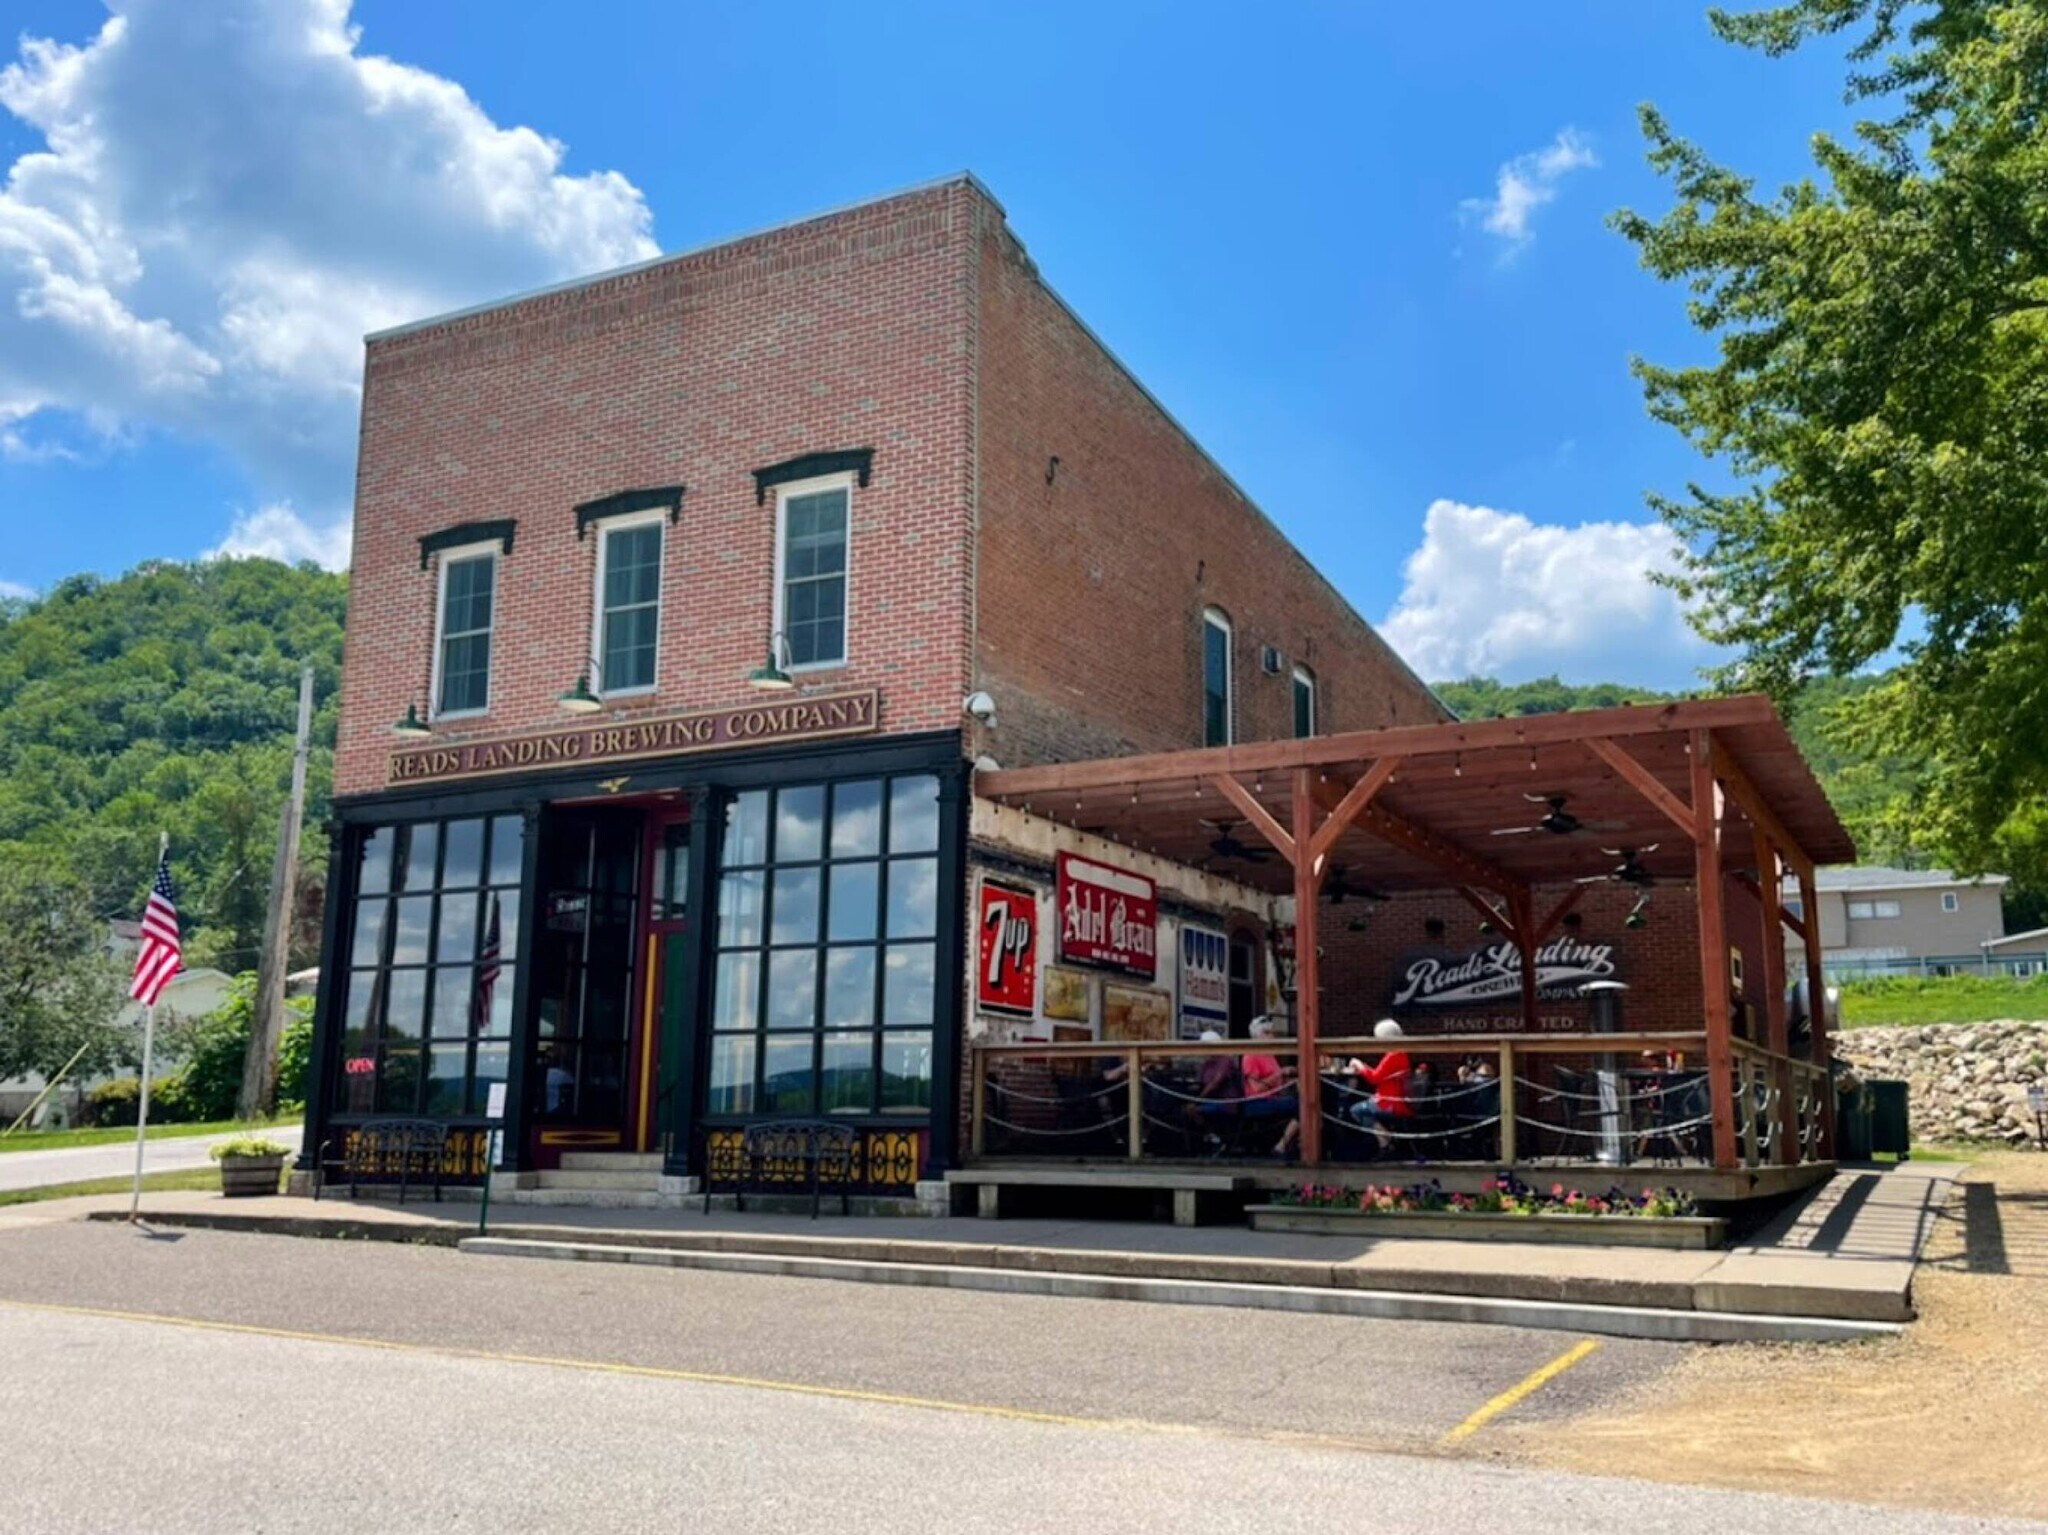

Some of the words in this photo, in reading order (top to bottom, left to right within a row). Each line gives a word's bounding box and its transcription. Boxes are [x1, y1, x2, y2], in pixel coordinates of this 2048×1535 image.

[389, 751, 460, 780] READS
[468, 734, 580, 770] LANDING
[589, 717, 716, 753] BREWING
[726, 696, 872, 737] COMPANY
[1394, 953, 1484, 1006] Reads
[1444, 1016, 1487, 1031] HAND
[1493, 1015, 1574, 1030] CRATED
[345, 1057, 375, 1074] OPEN
